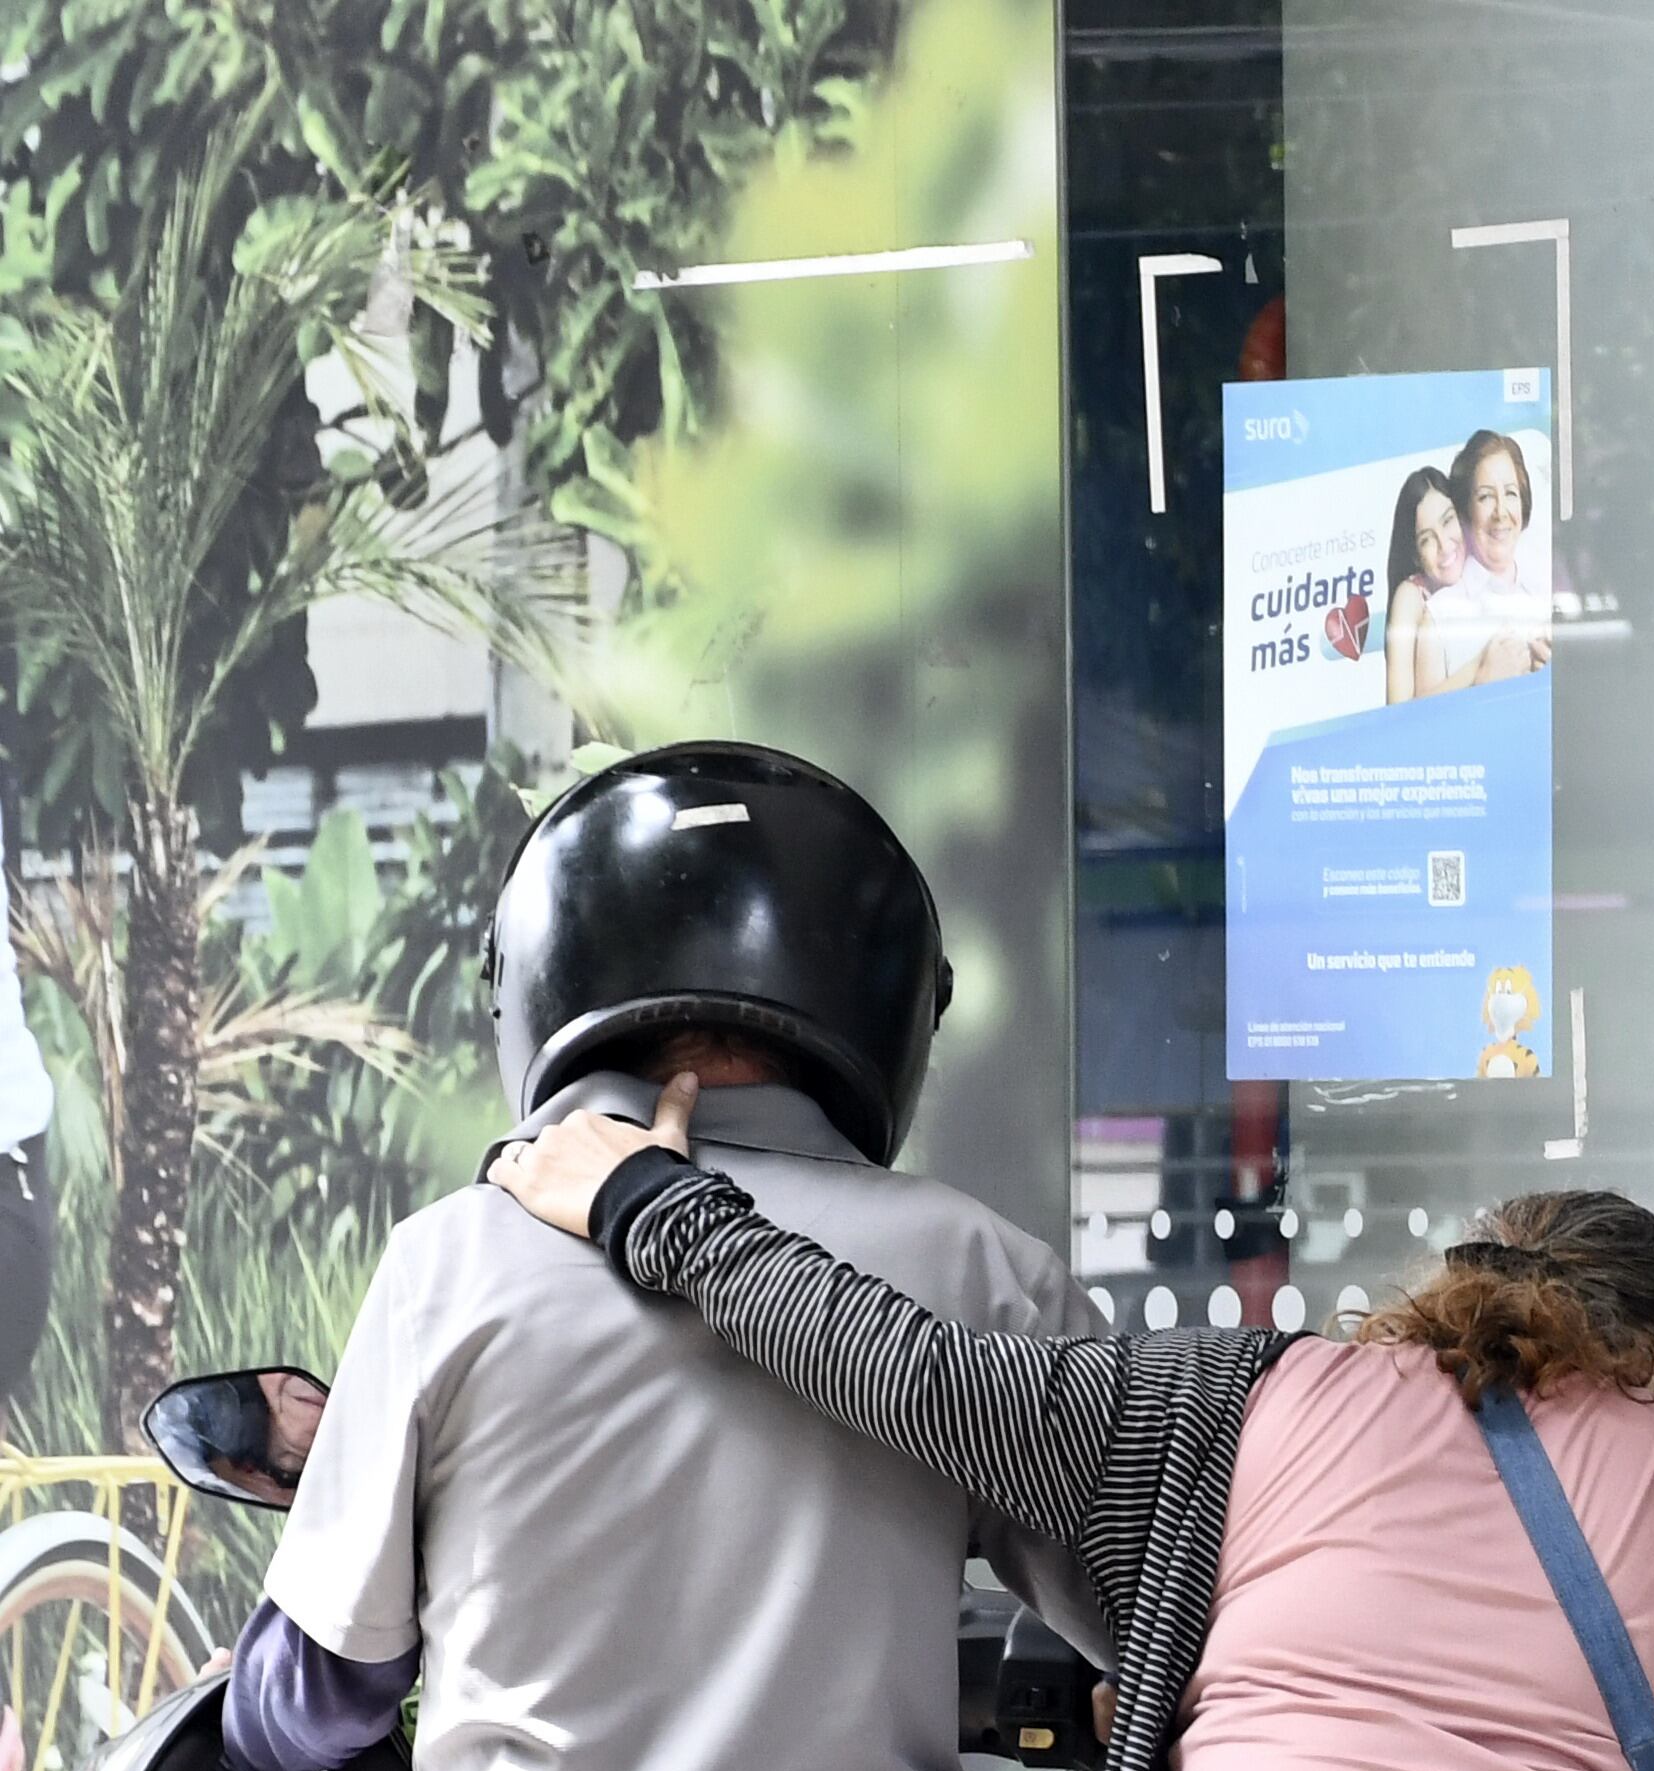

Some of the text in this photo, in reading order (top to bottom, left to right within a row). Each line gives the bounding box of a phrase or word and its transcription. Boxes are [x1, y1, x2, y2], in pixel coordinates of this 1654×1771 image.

[1511, 383, 1531, 396] EPS
[1244, 416, 1292, 441] sura
[1251, 529, 1376, 574] Conocerte más es
[1251, 566, 1375, 622] cuidarte
[1250, 624, 1311, 672] más
[1307, 949, 1476, 971] Un servicio que te entiende
